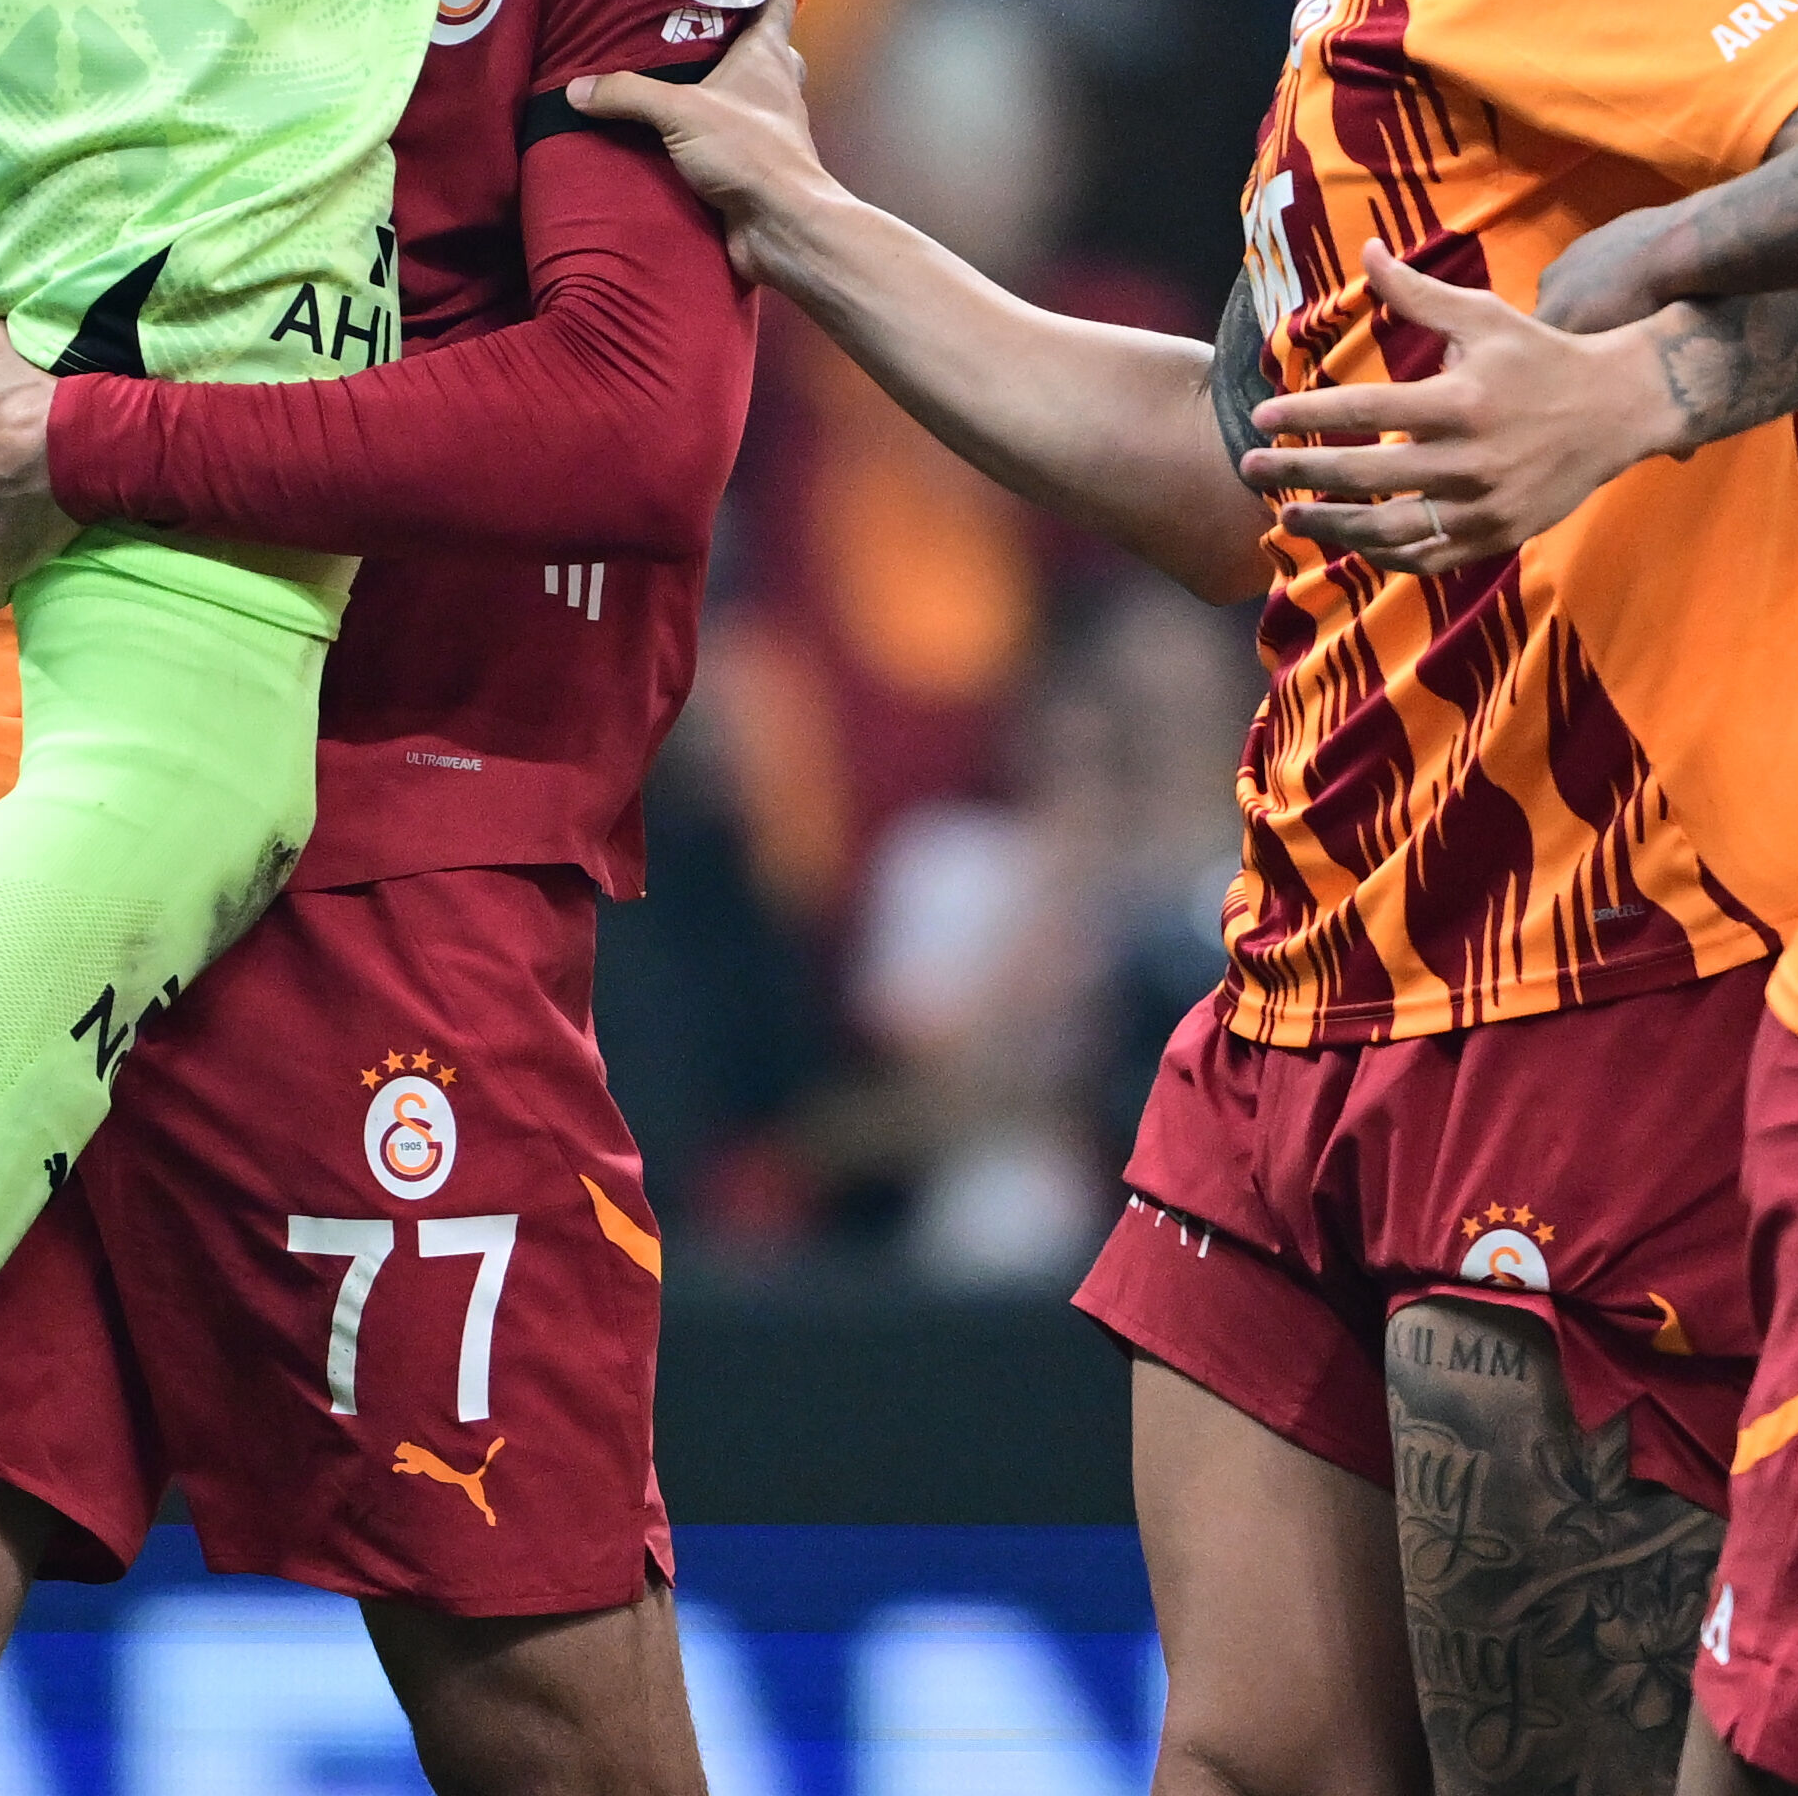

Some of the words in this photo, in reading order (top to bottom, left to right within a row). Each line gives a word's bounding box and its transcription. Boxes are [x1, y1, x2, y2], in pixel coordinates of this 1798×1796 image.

[406, 751, 483, 772] ULTRAWEAVE
[399, 1141, 422, 1152] 1905
[287, 1212, 519, 1423] 77
